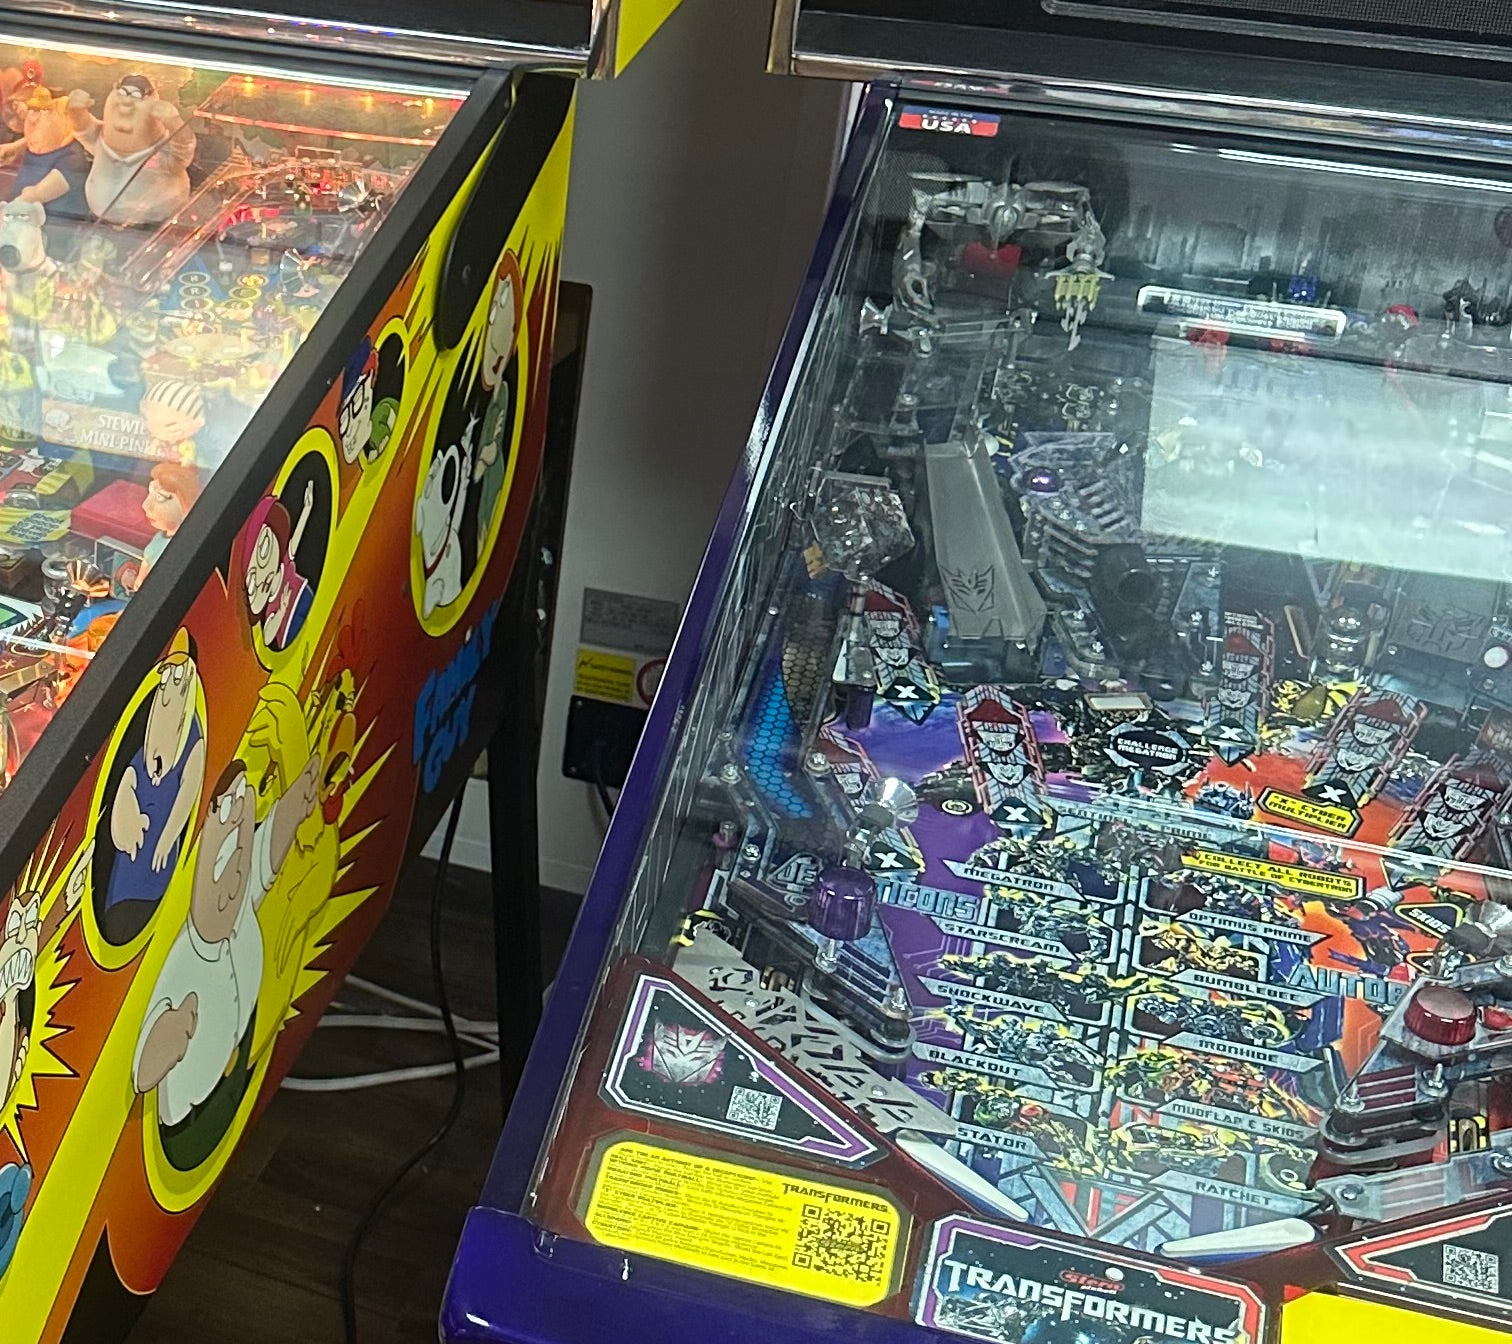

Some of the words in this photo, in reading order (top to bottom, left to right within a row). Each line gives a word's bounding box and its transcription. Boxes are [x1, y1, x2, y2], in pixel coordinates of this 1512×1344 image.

[921, 118, 971, 134] USA
[1117, 744, 1178, 761] MEGATRON
[1267, 799, 1348, 832] MULTIPLIER
[1299, 802, 1347, 823] CYBER
[963, 866, 1055, 891] MEGATRON
[1198, 859, 1221, 869] FOR
[1225, 863, 1266, 878] BATTLE
[1270, 872, 1285, 881] OF
[1288, 875, 1354, 893] CYBERTRON
[1204, 853, 1263, 869] COLLECT
[1267, 863, 1293, 875] ALL
[1298, 870, 1353, 887] ROBOTS
[1189, 912, 1257, 933] OPTIMUS
[1264, 926, 1312, 943] PRIME
[1408, 907, 1451, 935] SKIDS
[943, 922, 1061, 954] STARSCREAM
[938, 984, 1045, 1014] SHOCKWAVE
[1193, 973, 1300, 1002] BUMBLEBEE
[928, 1049, 1023, 1078] BLACKOUT
[1198, 1039, 1279, 1064] IRONHIDE
[1172, 1102, 1243, 1125] MUDFLAP
[1262, 1122, 1307, 1141] SKIDS
[957, 1126, 1028, 1152] STATOR
[781, 1182, 890, 1215] TRANSFORMERS
[1195, 1180, 1273, 1207] RATCHET
